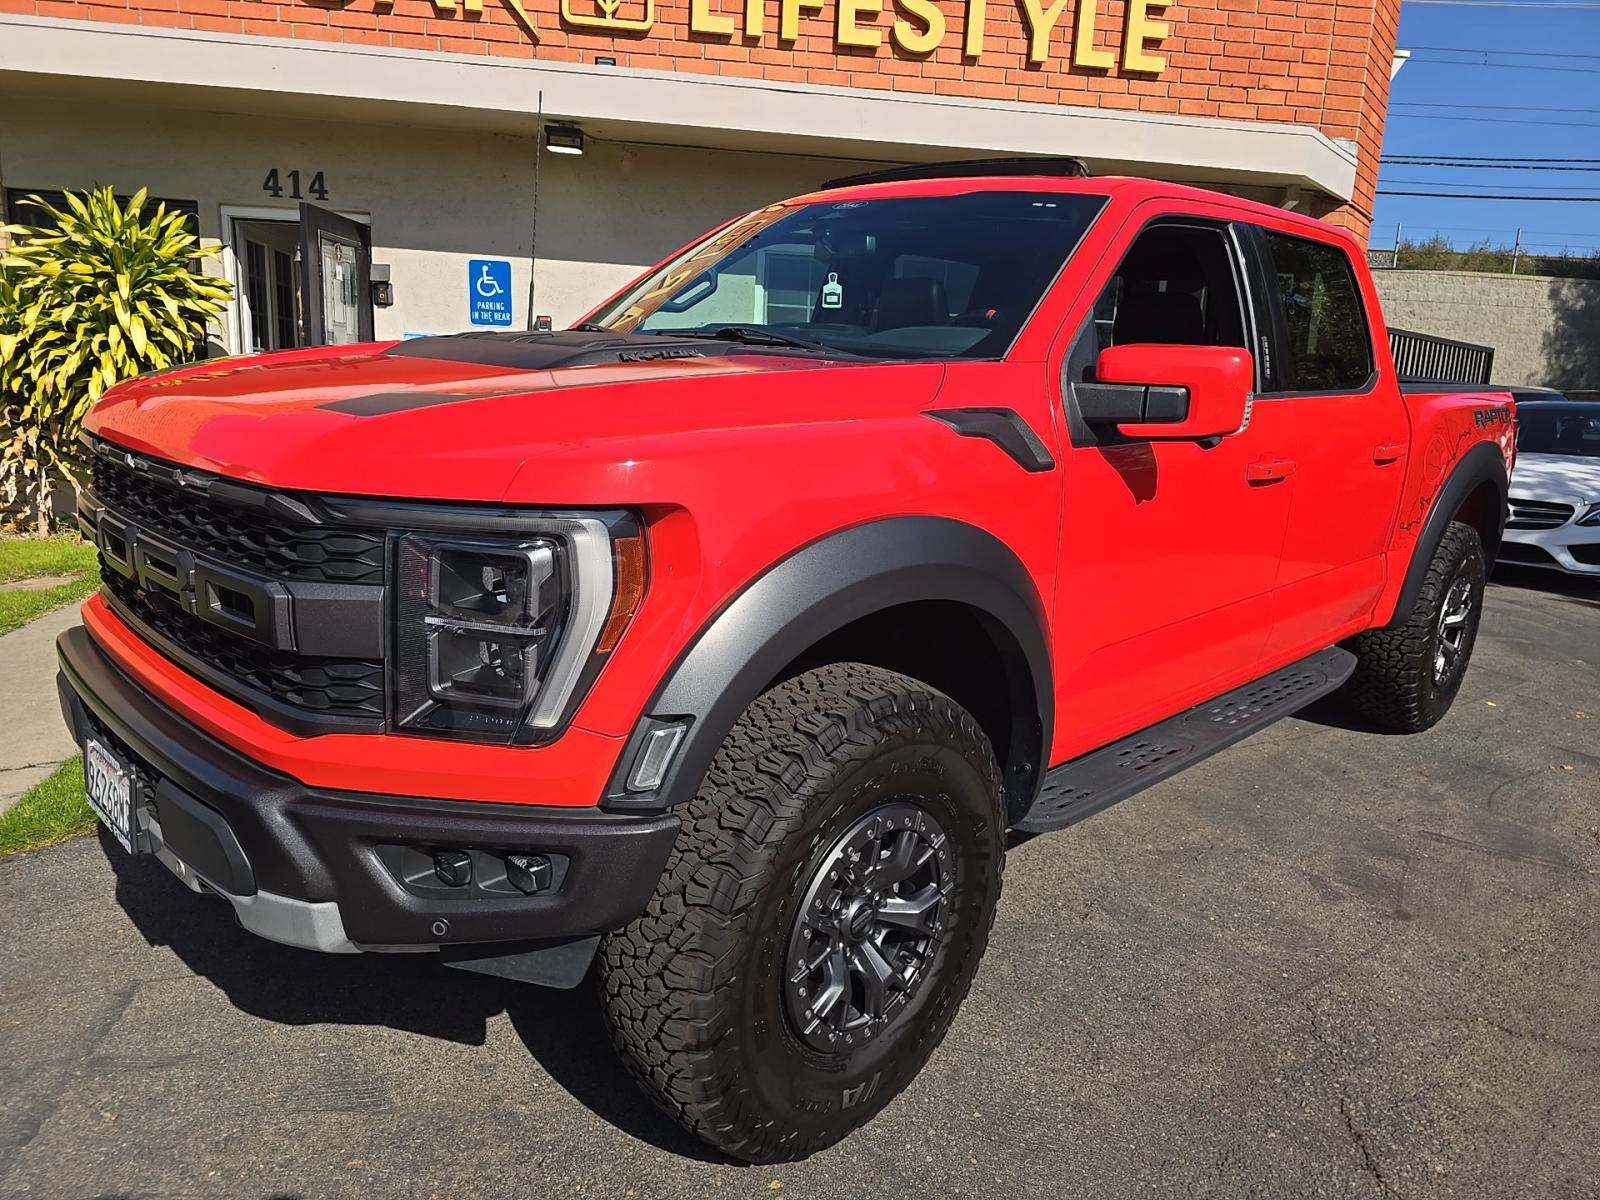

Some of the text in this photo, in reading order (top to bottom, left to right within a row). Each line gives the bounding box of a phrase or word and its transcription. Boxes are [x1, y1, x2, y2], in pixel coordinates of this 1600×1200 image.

[263, 168, 329, 201] 414
[477, 301, 505, 311] PARKING
[472, 311, 511, 321] IN THE REAR
[1472, 407, 1511, 428] RAPTO
